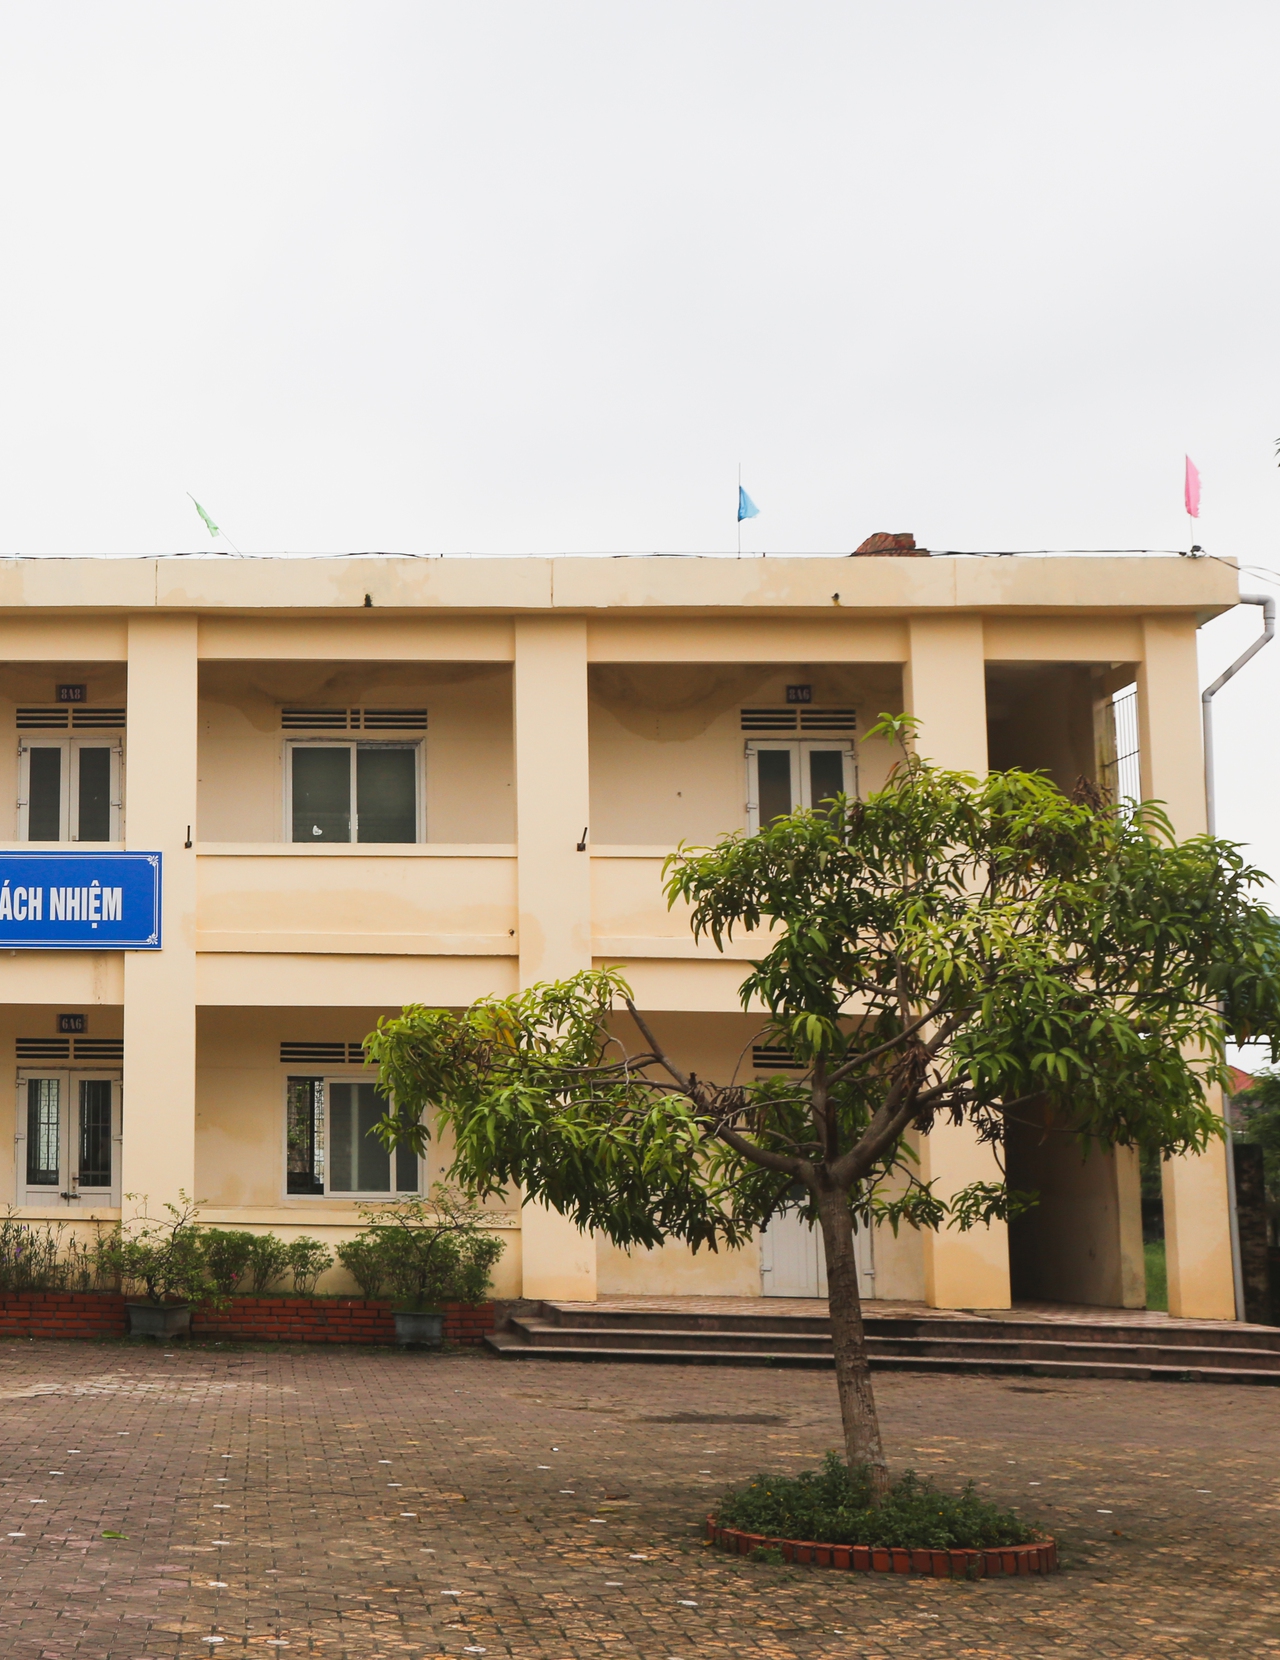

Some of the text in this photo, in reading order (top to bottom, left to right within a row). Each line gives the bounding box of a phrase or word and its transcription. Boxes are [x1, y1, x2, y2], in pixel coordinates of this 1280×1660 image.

[61, 688, 81, 700] 8A8
[50, 879, 123, 929] NHIỆM
[62, 1018, 82, 1030] 6A6
